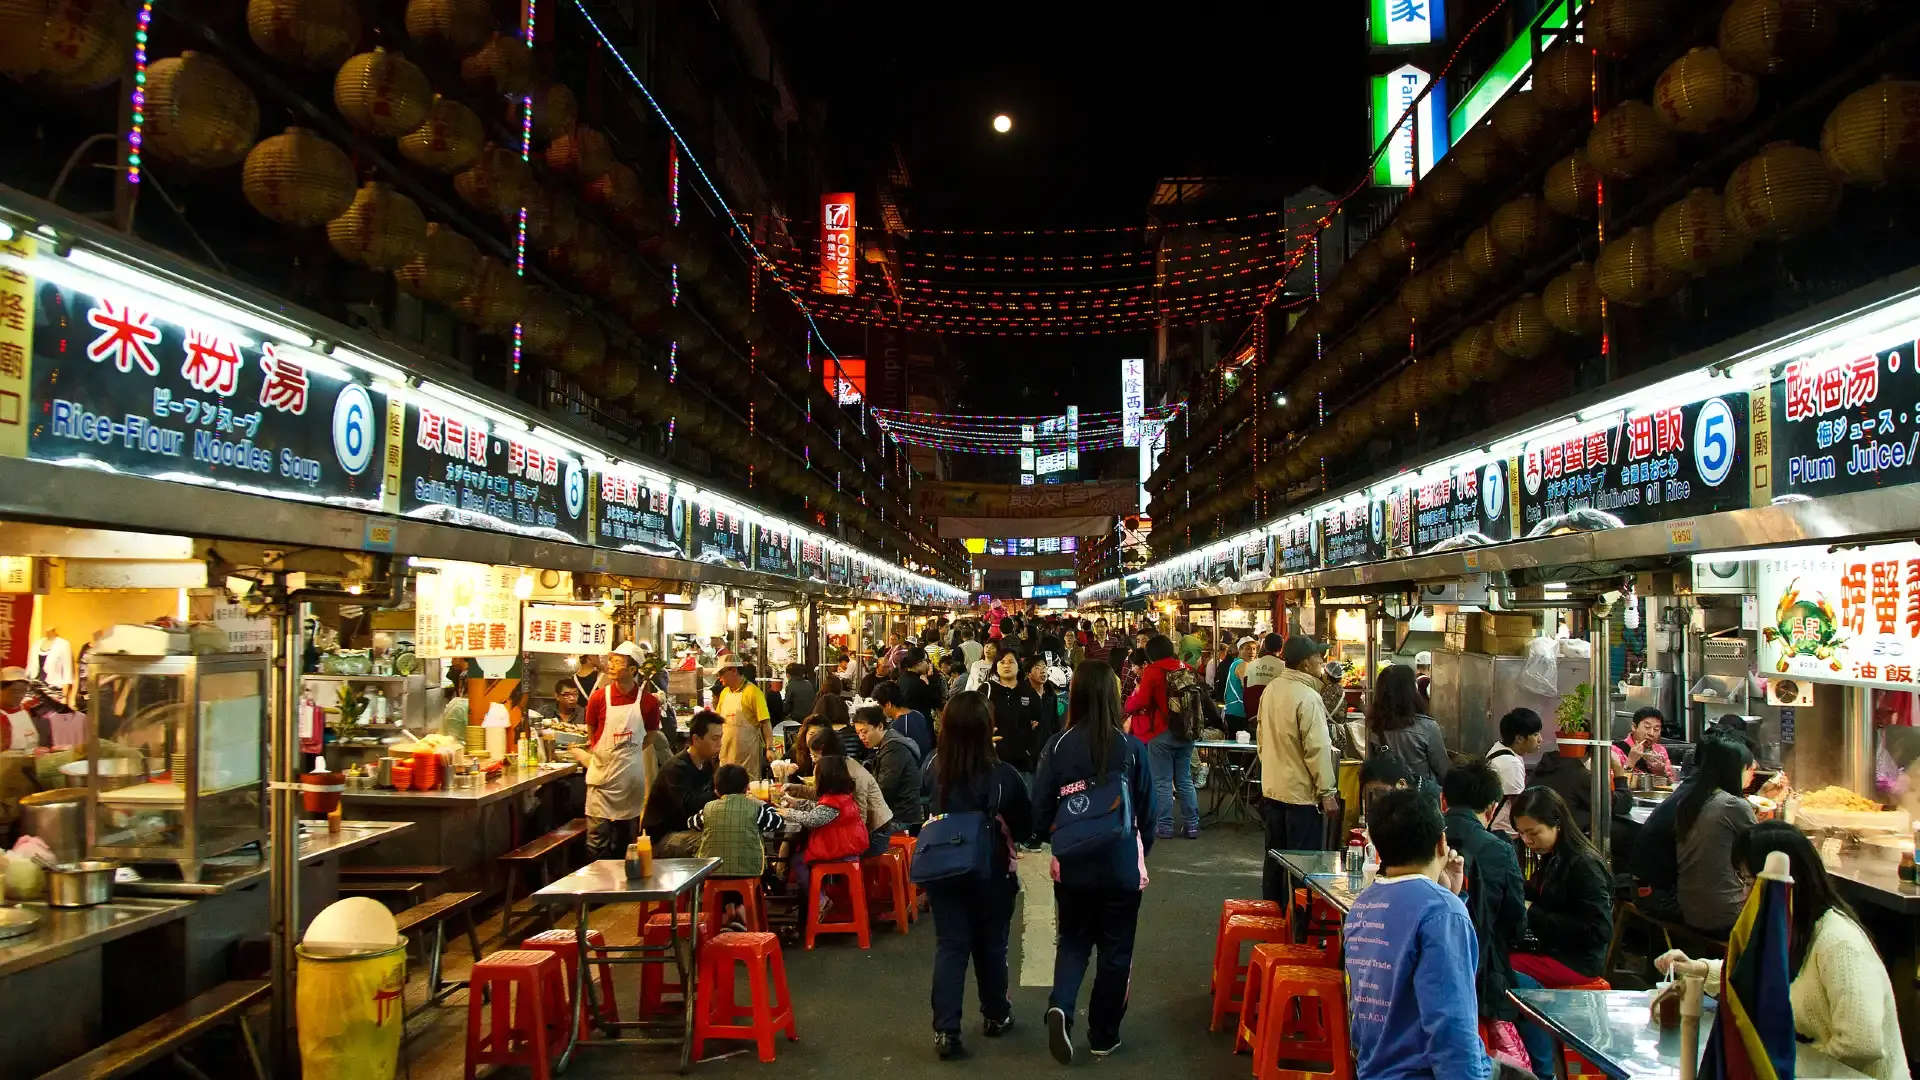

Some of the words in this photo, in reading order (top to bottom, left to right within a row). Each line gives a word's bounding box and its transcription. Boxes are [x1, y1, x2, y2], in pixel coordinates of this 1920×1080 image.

[88, 298, 309, 415] 米粉湯
[1786, 339, 1920, 422] 酸梅湯・
[153, 387, 263, 437] ビーフンスープ
[346, 403, 364, 456] 6
[52, 398, 184, 457] Rice-Flour
[194, 429, 272, 474] Noodles
[280, 448, 321, 484] Soup
[1703, 414, 1727, 479] 5
[570, 471, 579, 506] 8
[1488, 475, 1497, 510] 7
[1645, 482, 1660, 506] Oil
[1666, 479, 1691, 501] Rice
[1789, 455, 1836, 485] Plum
[1852, 661, 1913, 684] 油飯
